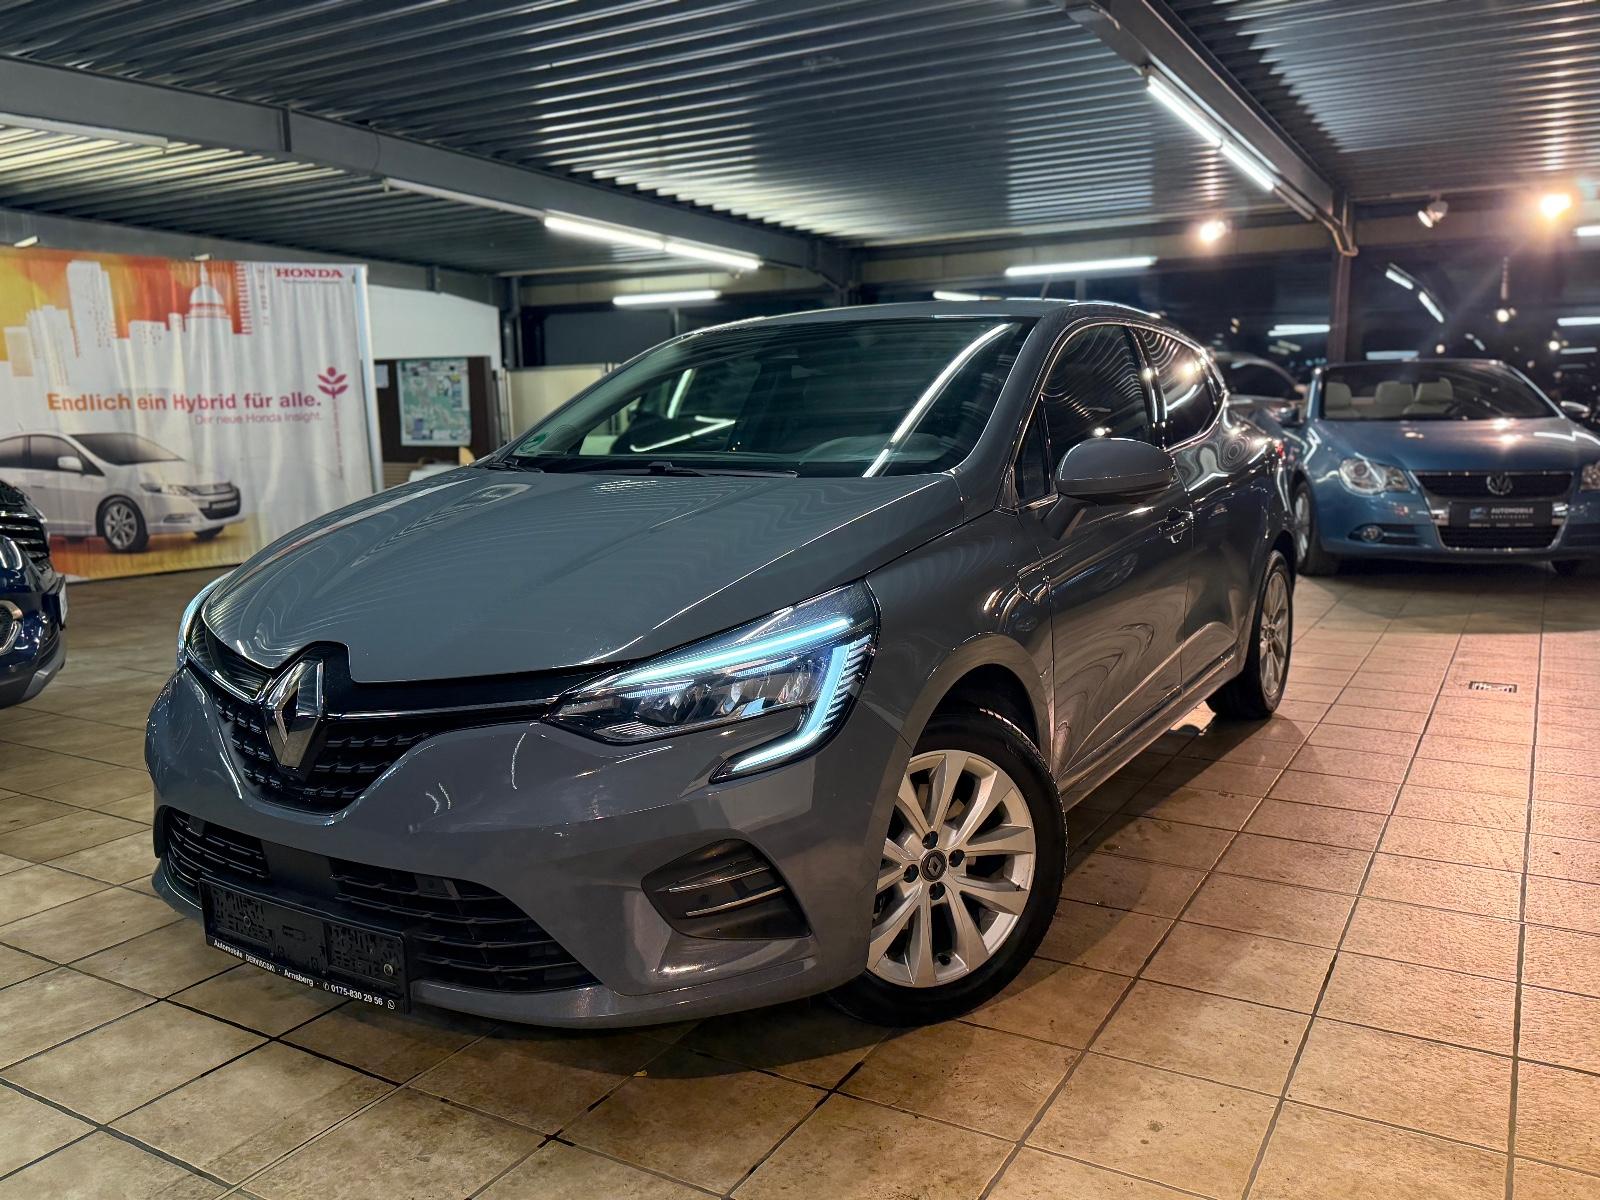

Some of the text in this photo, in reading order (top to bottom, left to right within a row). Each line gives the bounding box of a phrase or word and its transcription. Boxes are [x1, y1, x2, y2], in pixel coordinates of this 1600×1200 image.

[275, 268, 344, 278] HONDA
[47, 392, 322, 414] Endlich ein Hybrid für alle.
[194, 414, 213, 425] Der
[216, 415, 243, 425] neue
[245, 413, 282, 424] Honda
[284, 968, 314, 987] Arnsberg
[330, 984, 363, 1000] 0175-830
[363, 993, 373, 1004] 29
[374, 995, 384, 1006] 56
